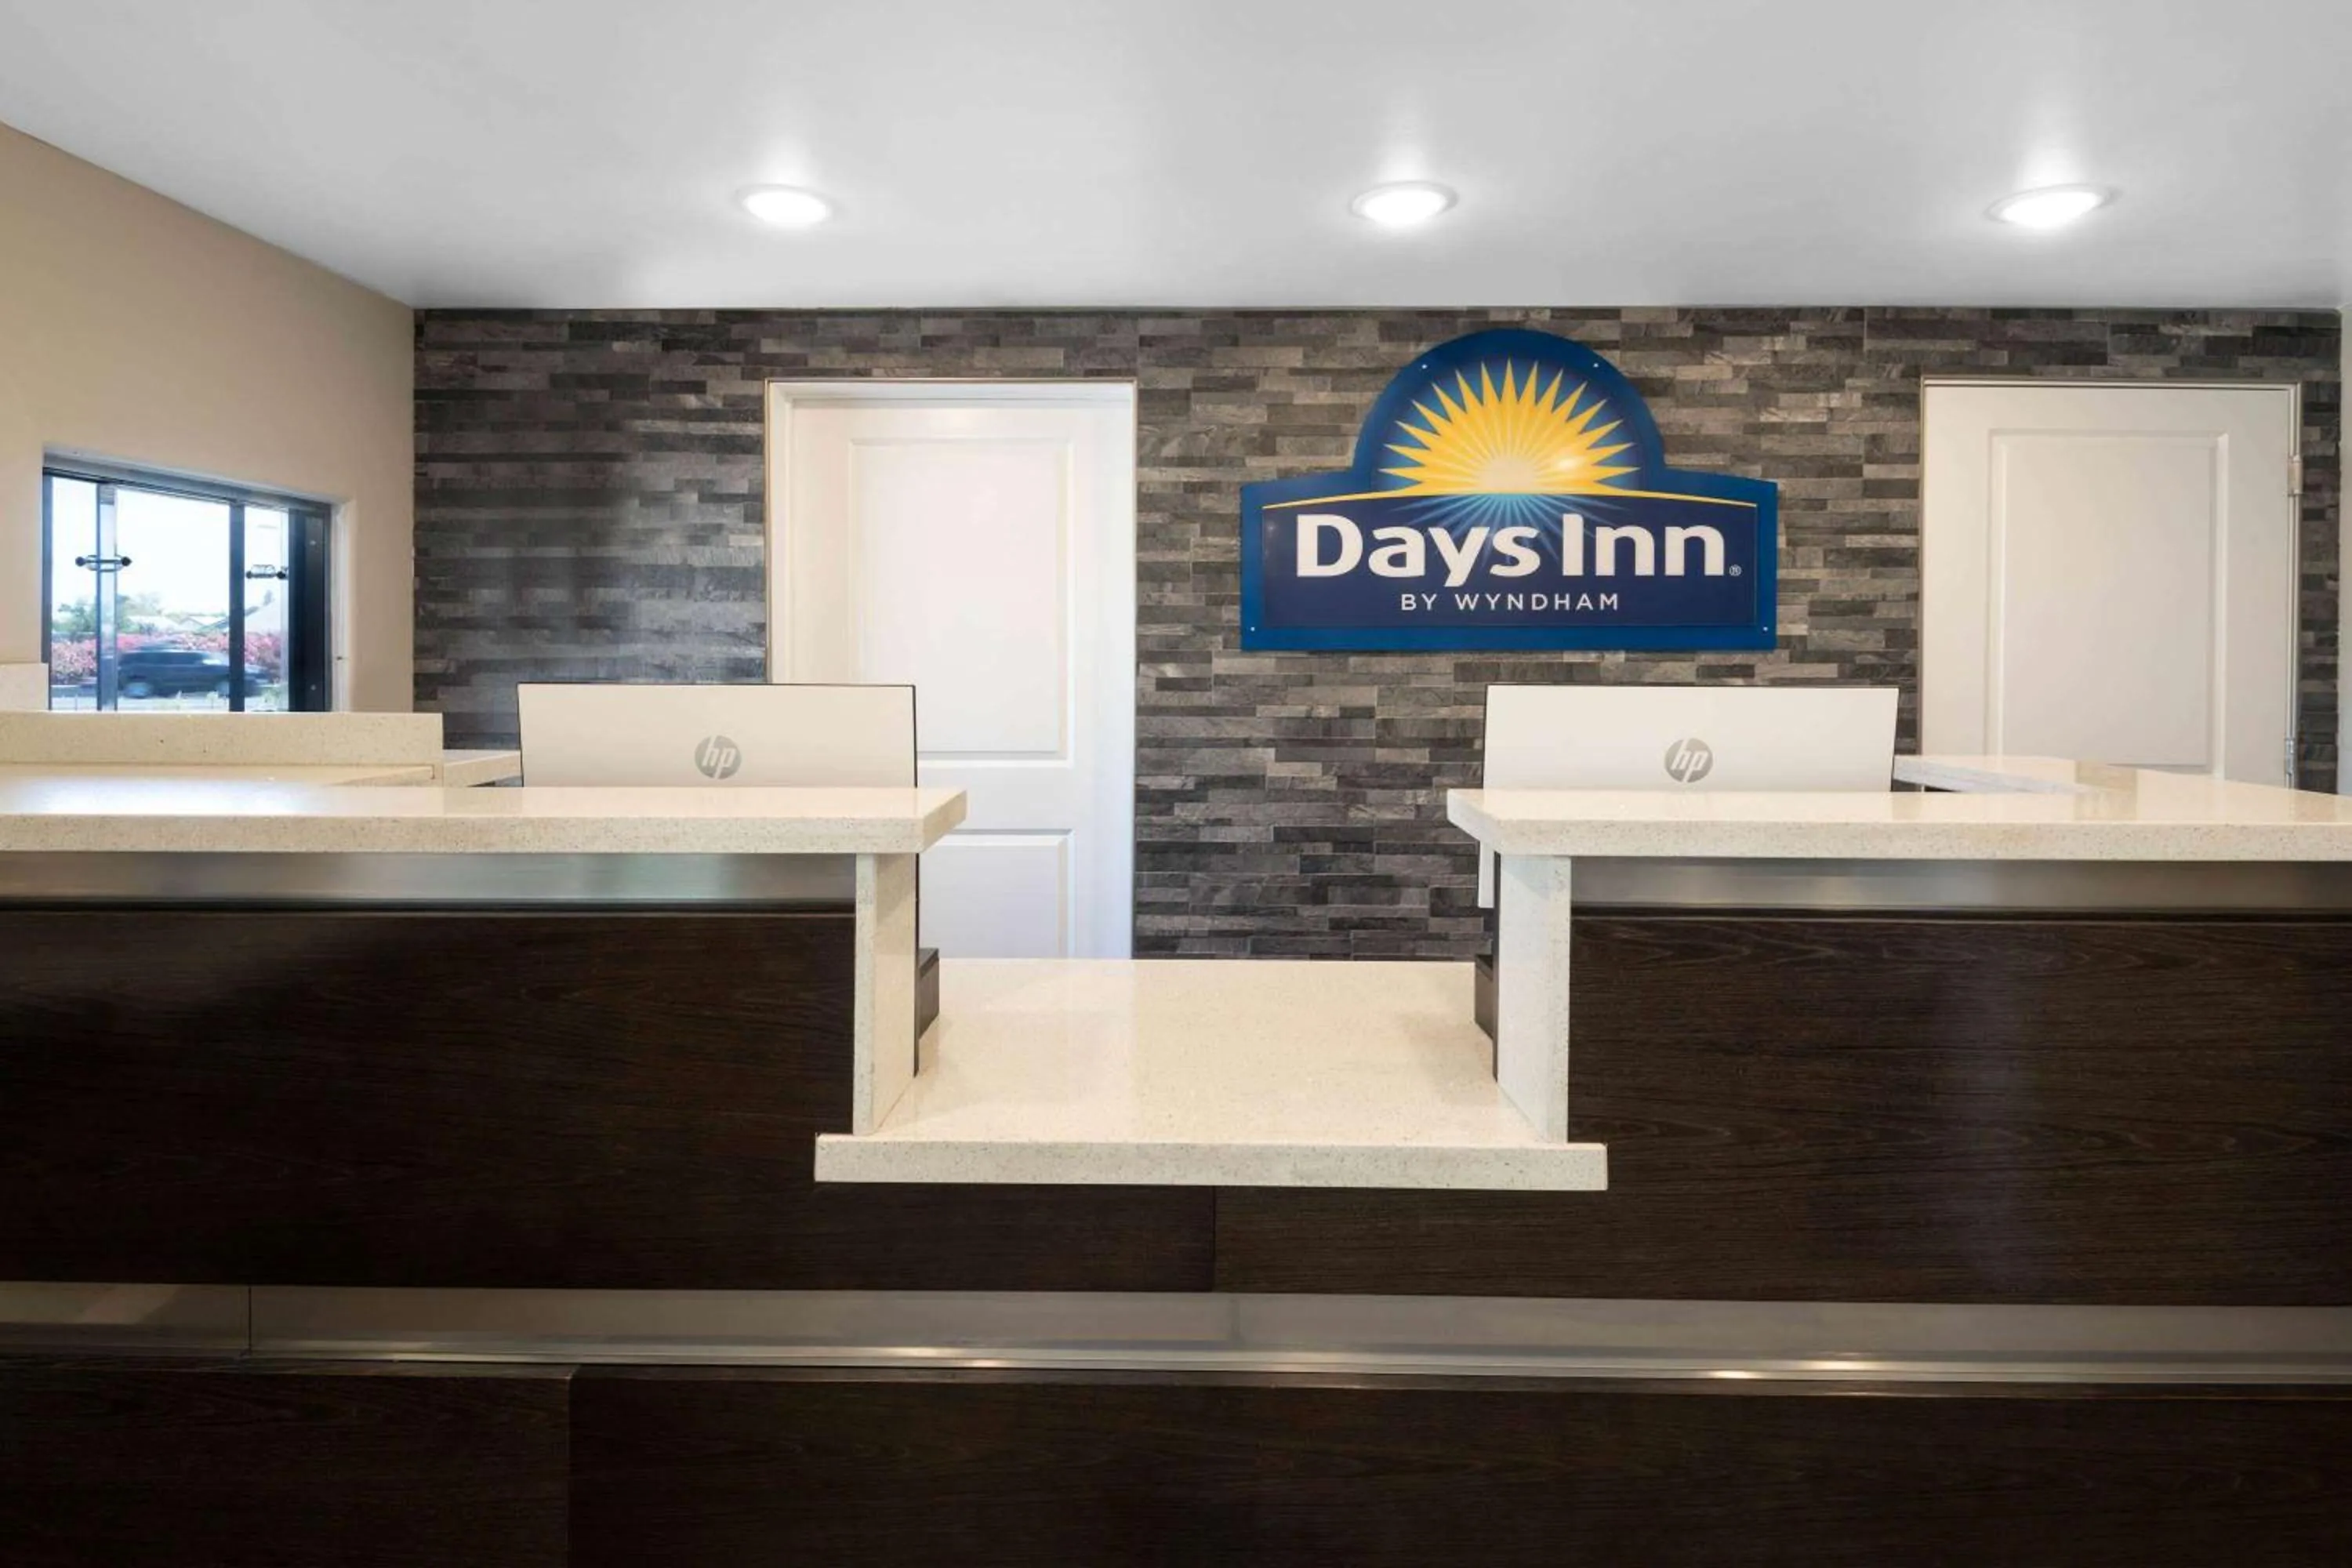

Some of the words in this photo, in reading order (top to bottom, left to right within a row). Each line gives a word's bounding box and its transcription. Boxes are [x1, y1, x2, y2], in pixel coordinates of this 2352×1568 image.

[1296, 514, 1541, 587] Days
[1562, 514, 1725, 577] Inn
[1400, 593, 1437, 612] BY
[1454, 593, 1621, 612] WYNDHAM
[702, 735, 736, 779] hp
[1671, 738, 1708, 782] hp
